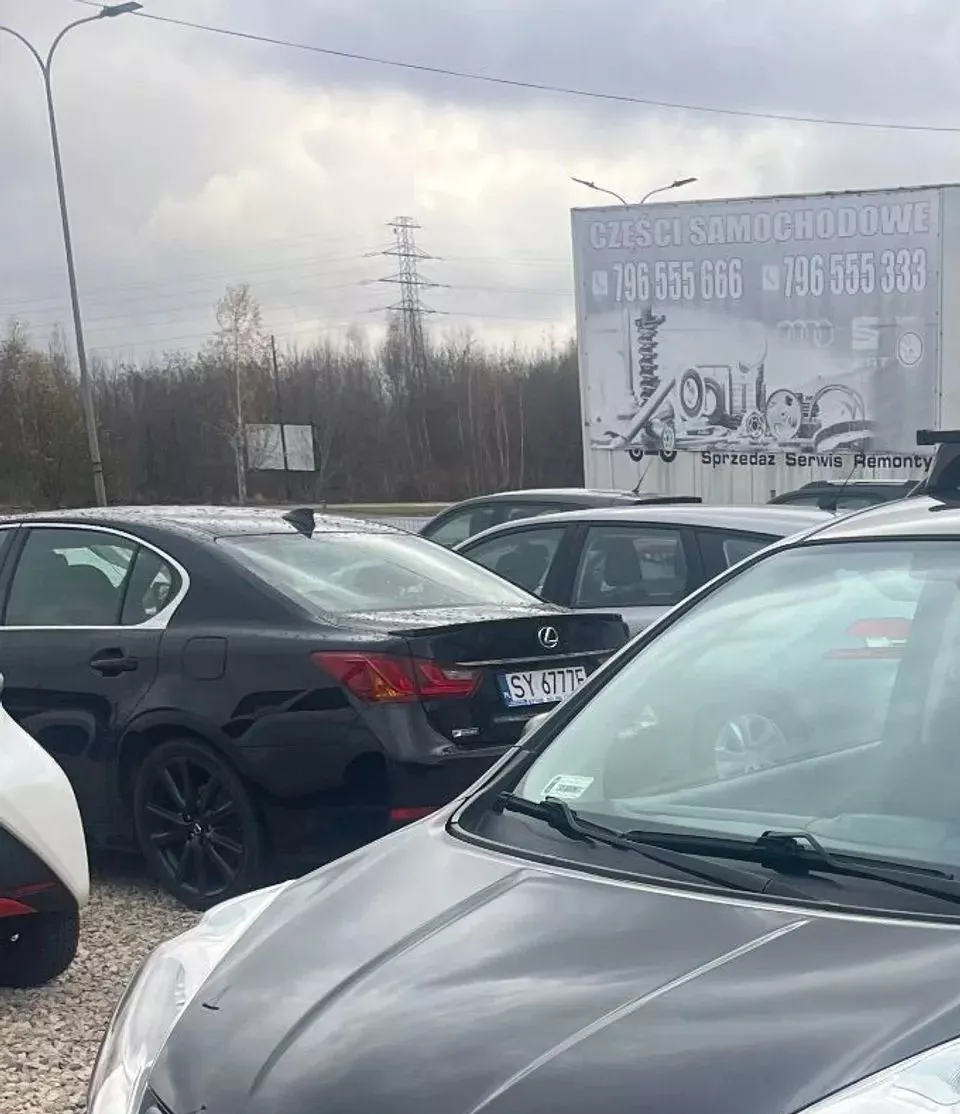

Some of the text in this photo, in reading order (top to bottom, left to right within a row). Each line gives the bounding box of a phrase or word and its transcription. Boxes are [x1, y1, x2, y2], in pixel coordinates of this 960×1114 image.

[589, 201, 931, 250] CZĘŚCI SAMOCHODOWE
[613, 256, 744, 302] 796 555 666
[783, 247, 928, 298] 796 555 333
[785, 452, 843, 468] Serwis
[853, 453, 933, 473] Remonty
[511, 673, 535, 699] SY
